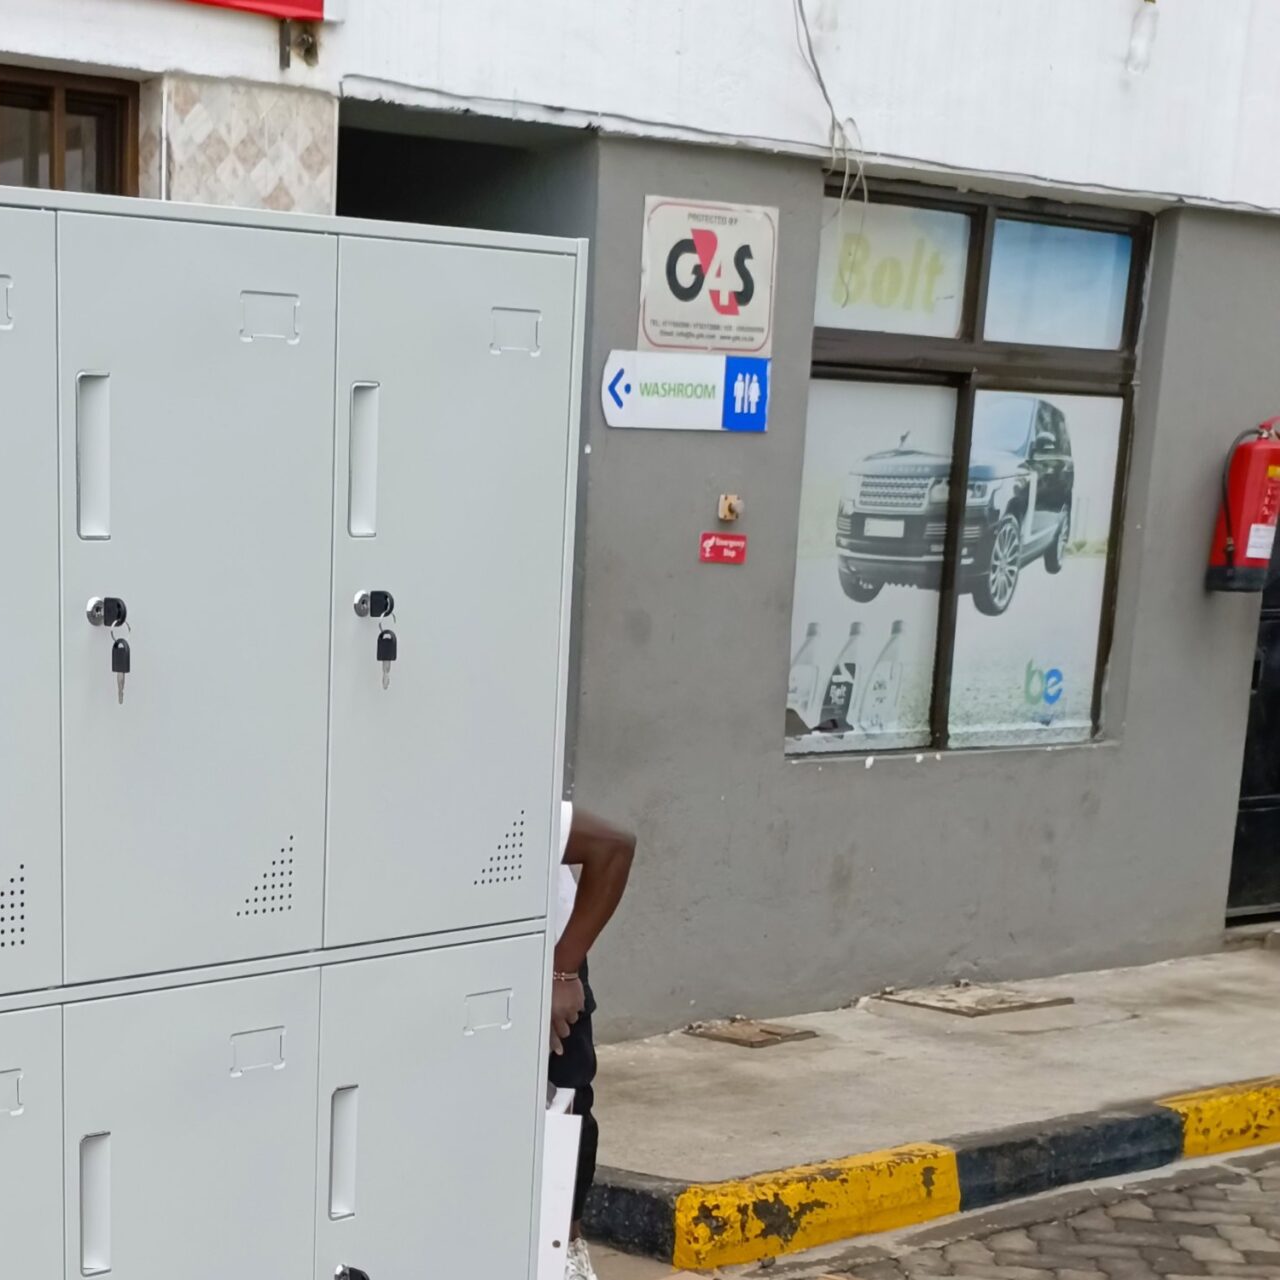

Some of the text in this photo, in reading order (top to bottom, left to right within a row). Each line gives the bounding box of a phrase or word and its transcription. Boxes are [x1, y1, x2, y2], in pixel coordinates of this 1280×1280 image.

[665, 228, 755, 316] G4S
[832, 232, 944, 315] Bolt
[639, 381, 716, 399] WASHROOM
